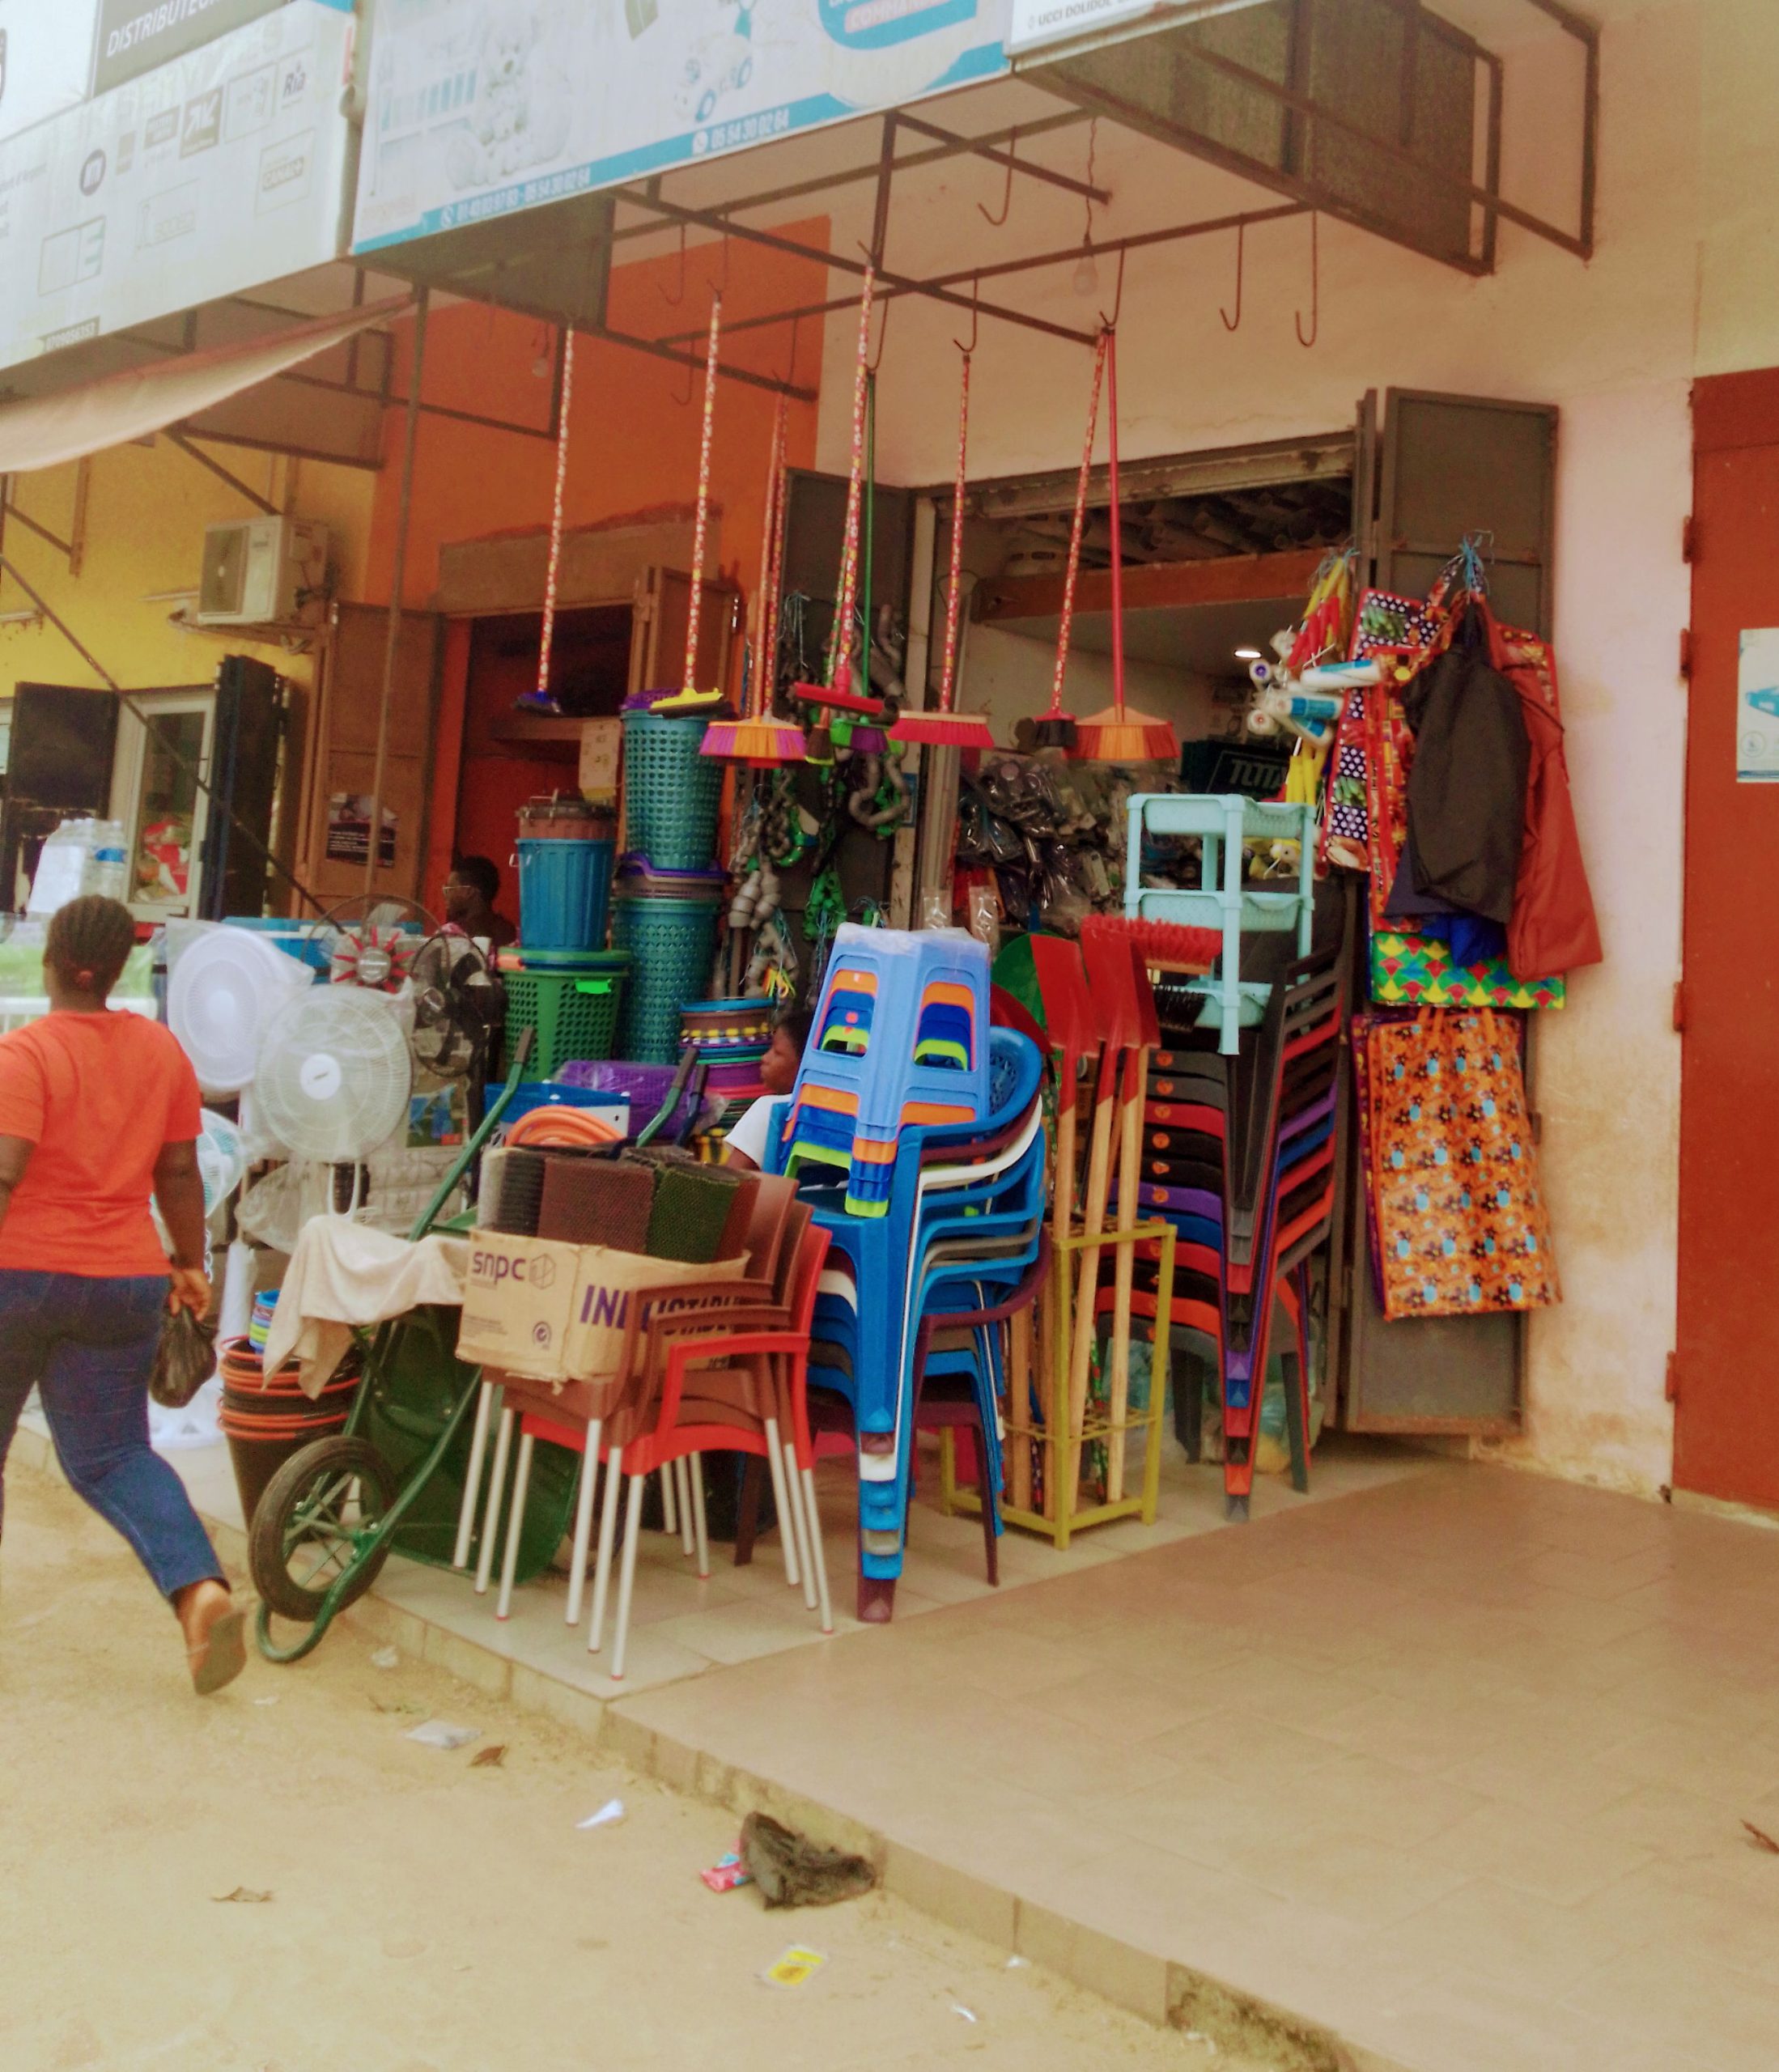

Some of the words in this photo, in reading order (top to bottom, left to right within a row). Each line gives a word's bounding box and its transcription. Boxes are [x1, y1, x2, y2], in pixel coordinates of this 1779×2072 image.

[106, 0, 220, 57] DISTRIBUTE
[1229, 758, 1287, 789] TOTA
[471, 1250, 528, 1286] snpc
